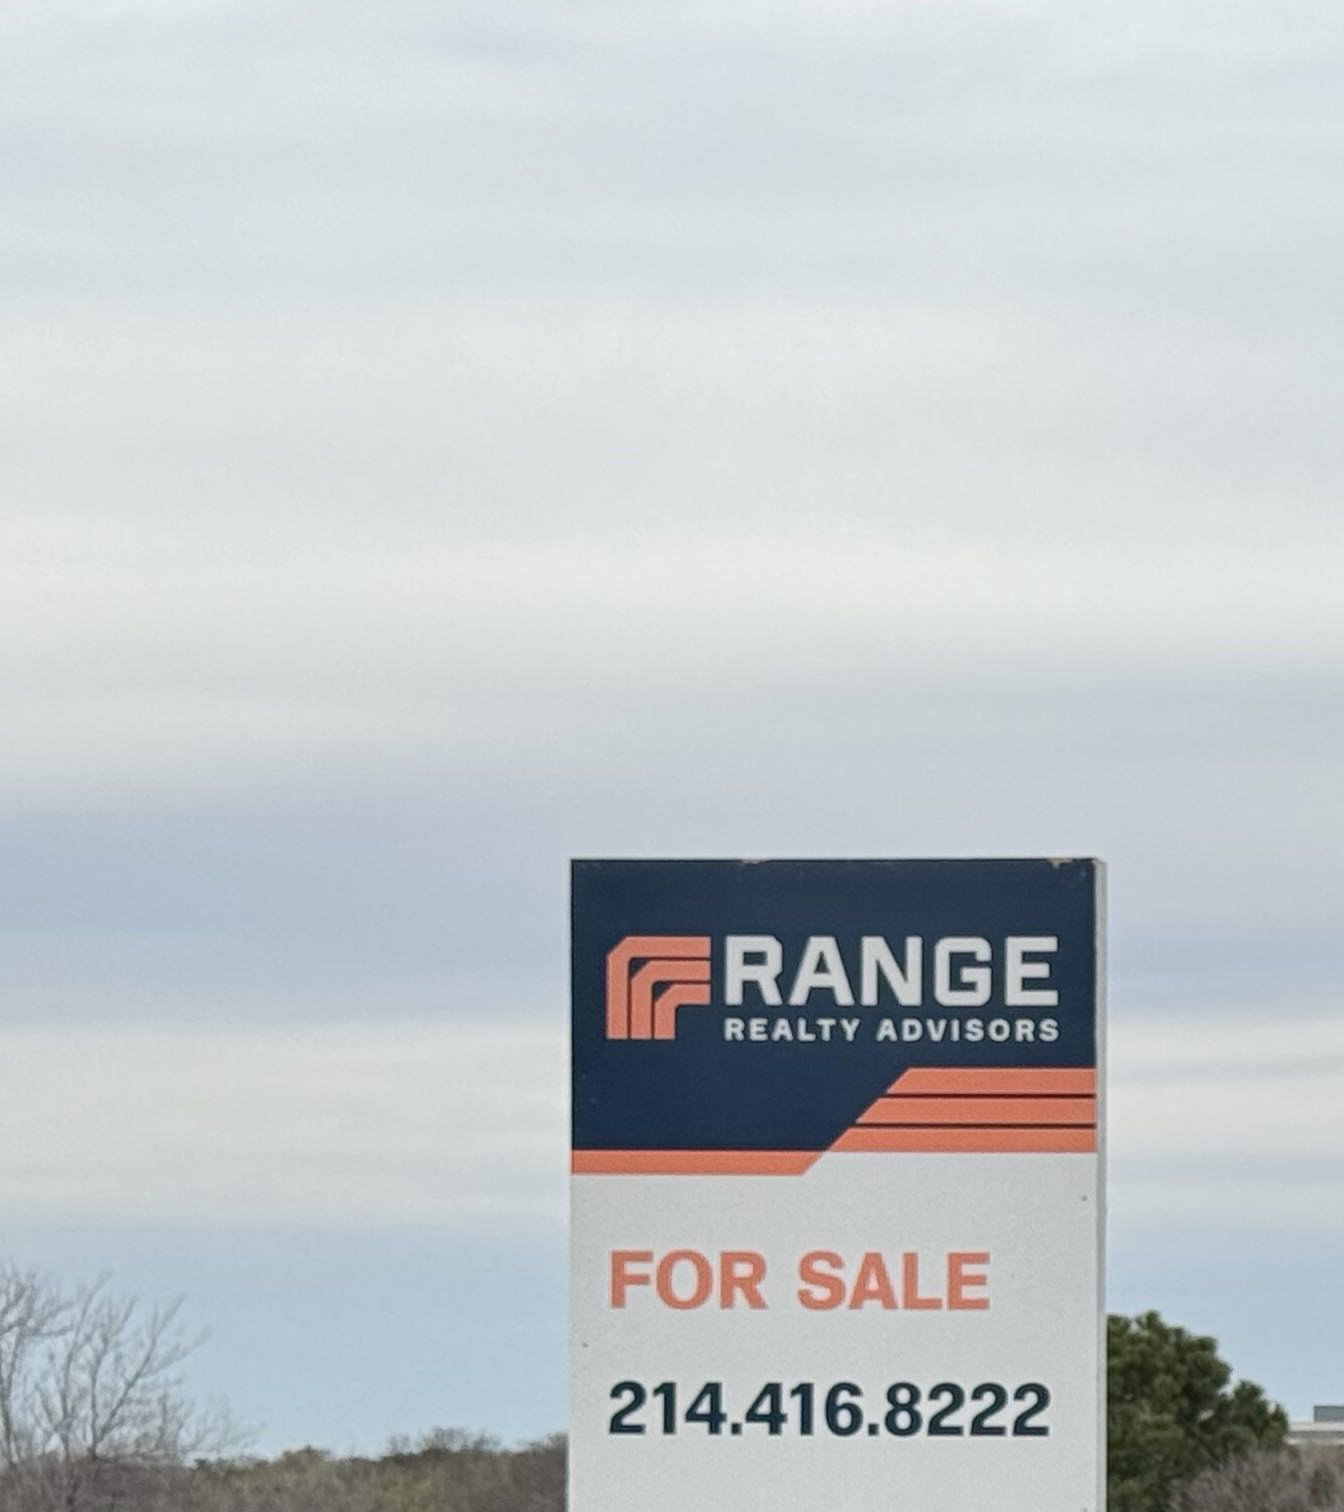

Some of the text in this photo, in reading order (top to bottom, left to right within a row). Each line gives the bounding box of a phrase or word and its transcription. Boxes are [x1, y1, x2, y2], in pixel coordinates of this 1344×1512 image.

[724, 935, 1060, 1006] RANGE
[724, 1018, 1061, 1042] REALTY ADVISORS
[609, 1250, 991, 1311] FOR SALE
[608, 1380, 1051, 1437] 214.416.8222
